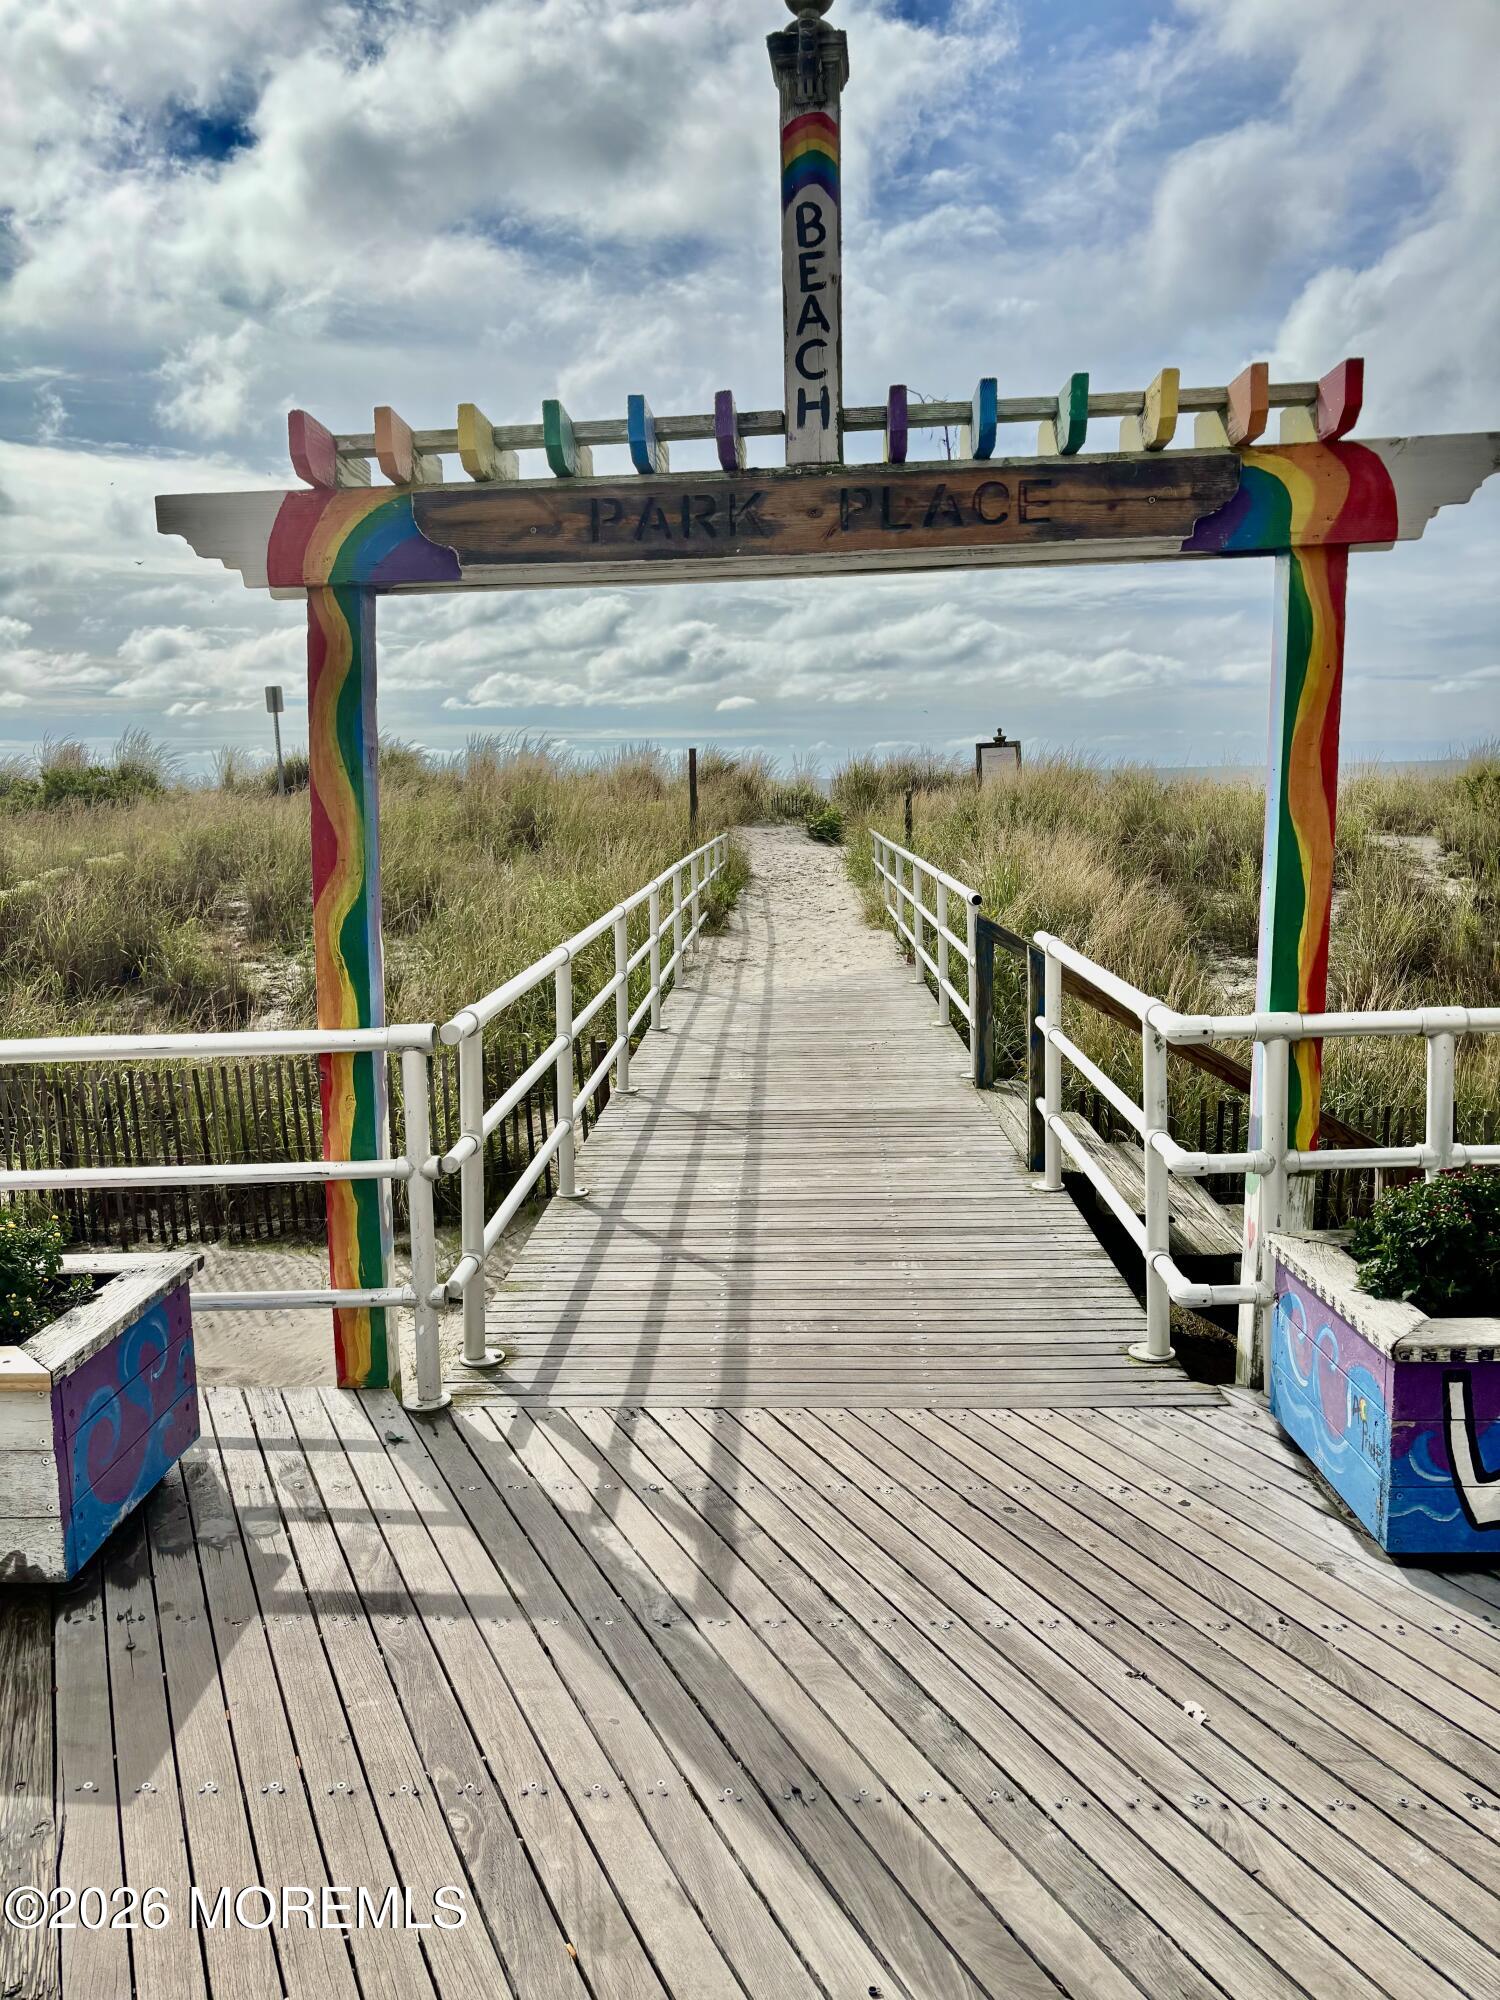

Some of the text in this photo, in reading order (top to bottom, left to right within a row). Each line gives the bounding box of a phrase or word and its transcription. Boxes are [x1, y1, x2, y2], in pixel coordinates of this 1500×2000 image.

[795, 200, 831, 430] BEACH
[591, 478, 1052, 543] PARK PLACE
